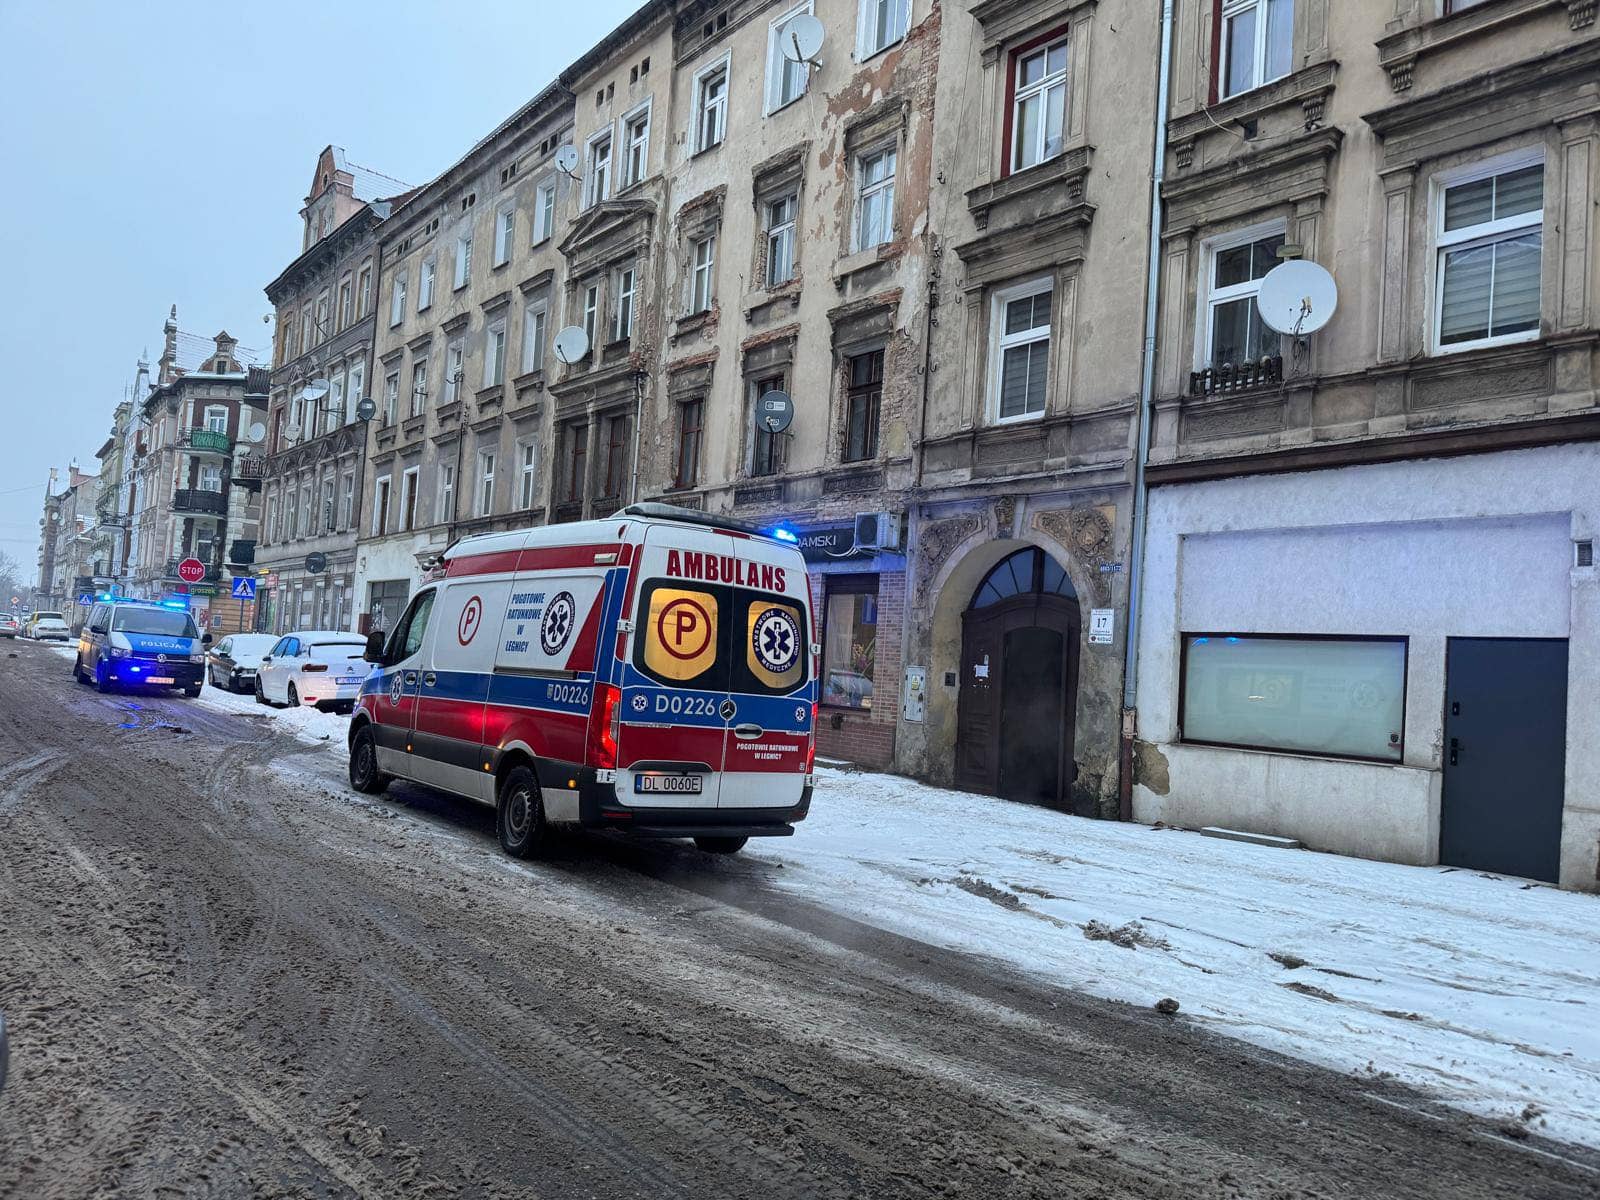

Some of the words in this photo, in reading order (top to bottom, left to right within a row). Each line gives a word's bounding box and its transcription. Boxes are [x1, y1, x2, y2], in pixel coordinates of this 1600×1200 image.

[181, 566, 203, 575] STOP
[666, 549, 786, 593] AMBULANS
[191, 587, 216, 595] groszek
[512, 593, 546, 604] POGOTOWIE
[507, 609, 542, 620] RATUNKOWE
[463, 607, 475, 634] P
[1097, 617, 1107, 628] 17
[517, 624, 525, 635] W
[675, 610, 697, 645] P
[141, 640, 182, 649] POLICJA
[505, 640, 529, 653] LEGNICY
[761, 658, 792, 672] MEDYCZNE
[736, 743, 768, 751] POGOTOWIE
[769, 744, 799, 752] RATUNKOWE
[754, 752, 761, 760] W
[761, 752, 782, 760] LEGNICY
[644, 777, 659, 790] DL
[663, 777, 699, 791] 0060E
